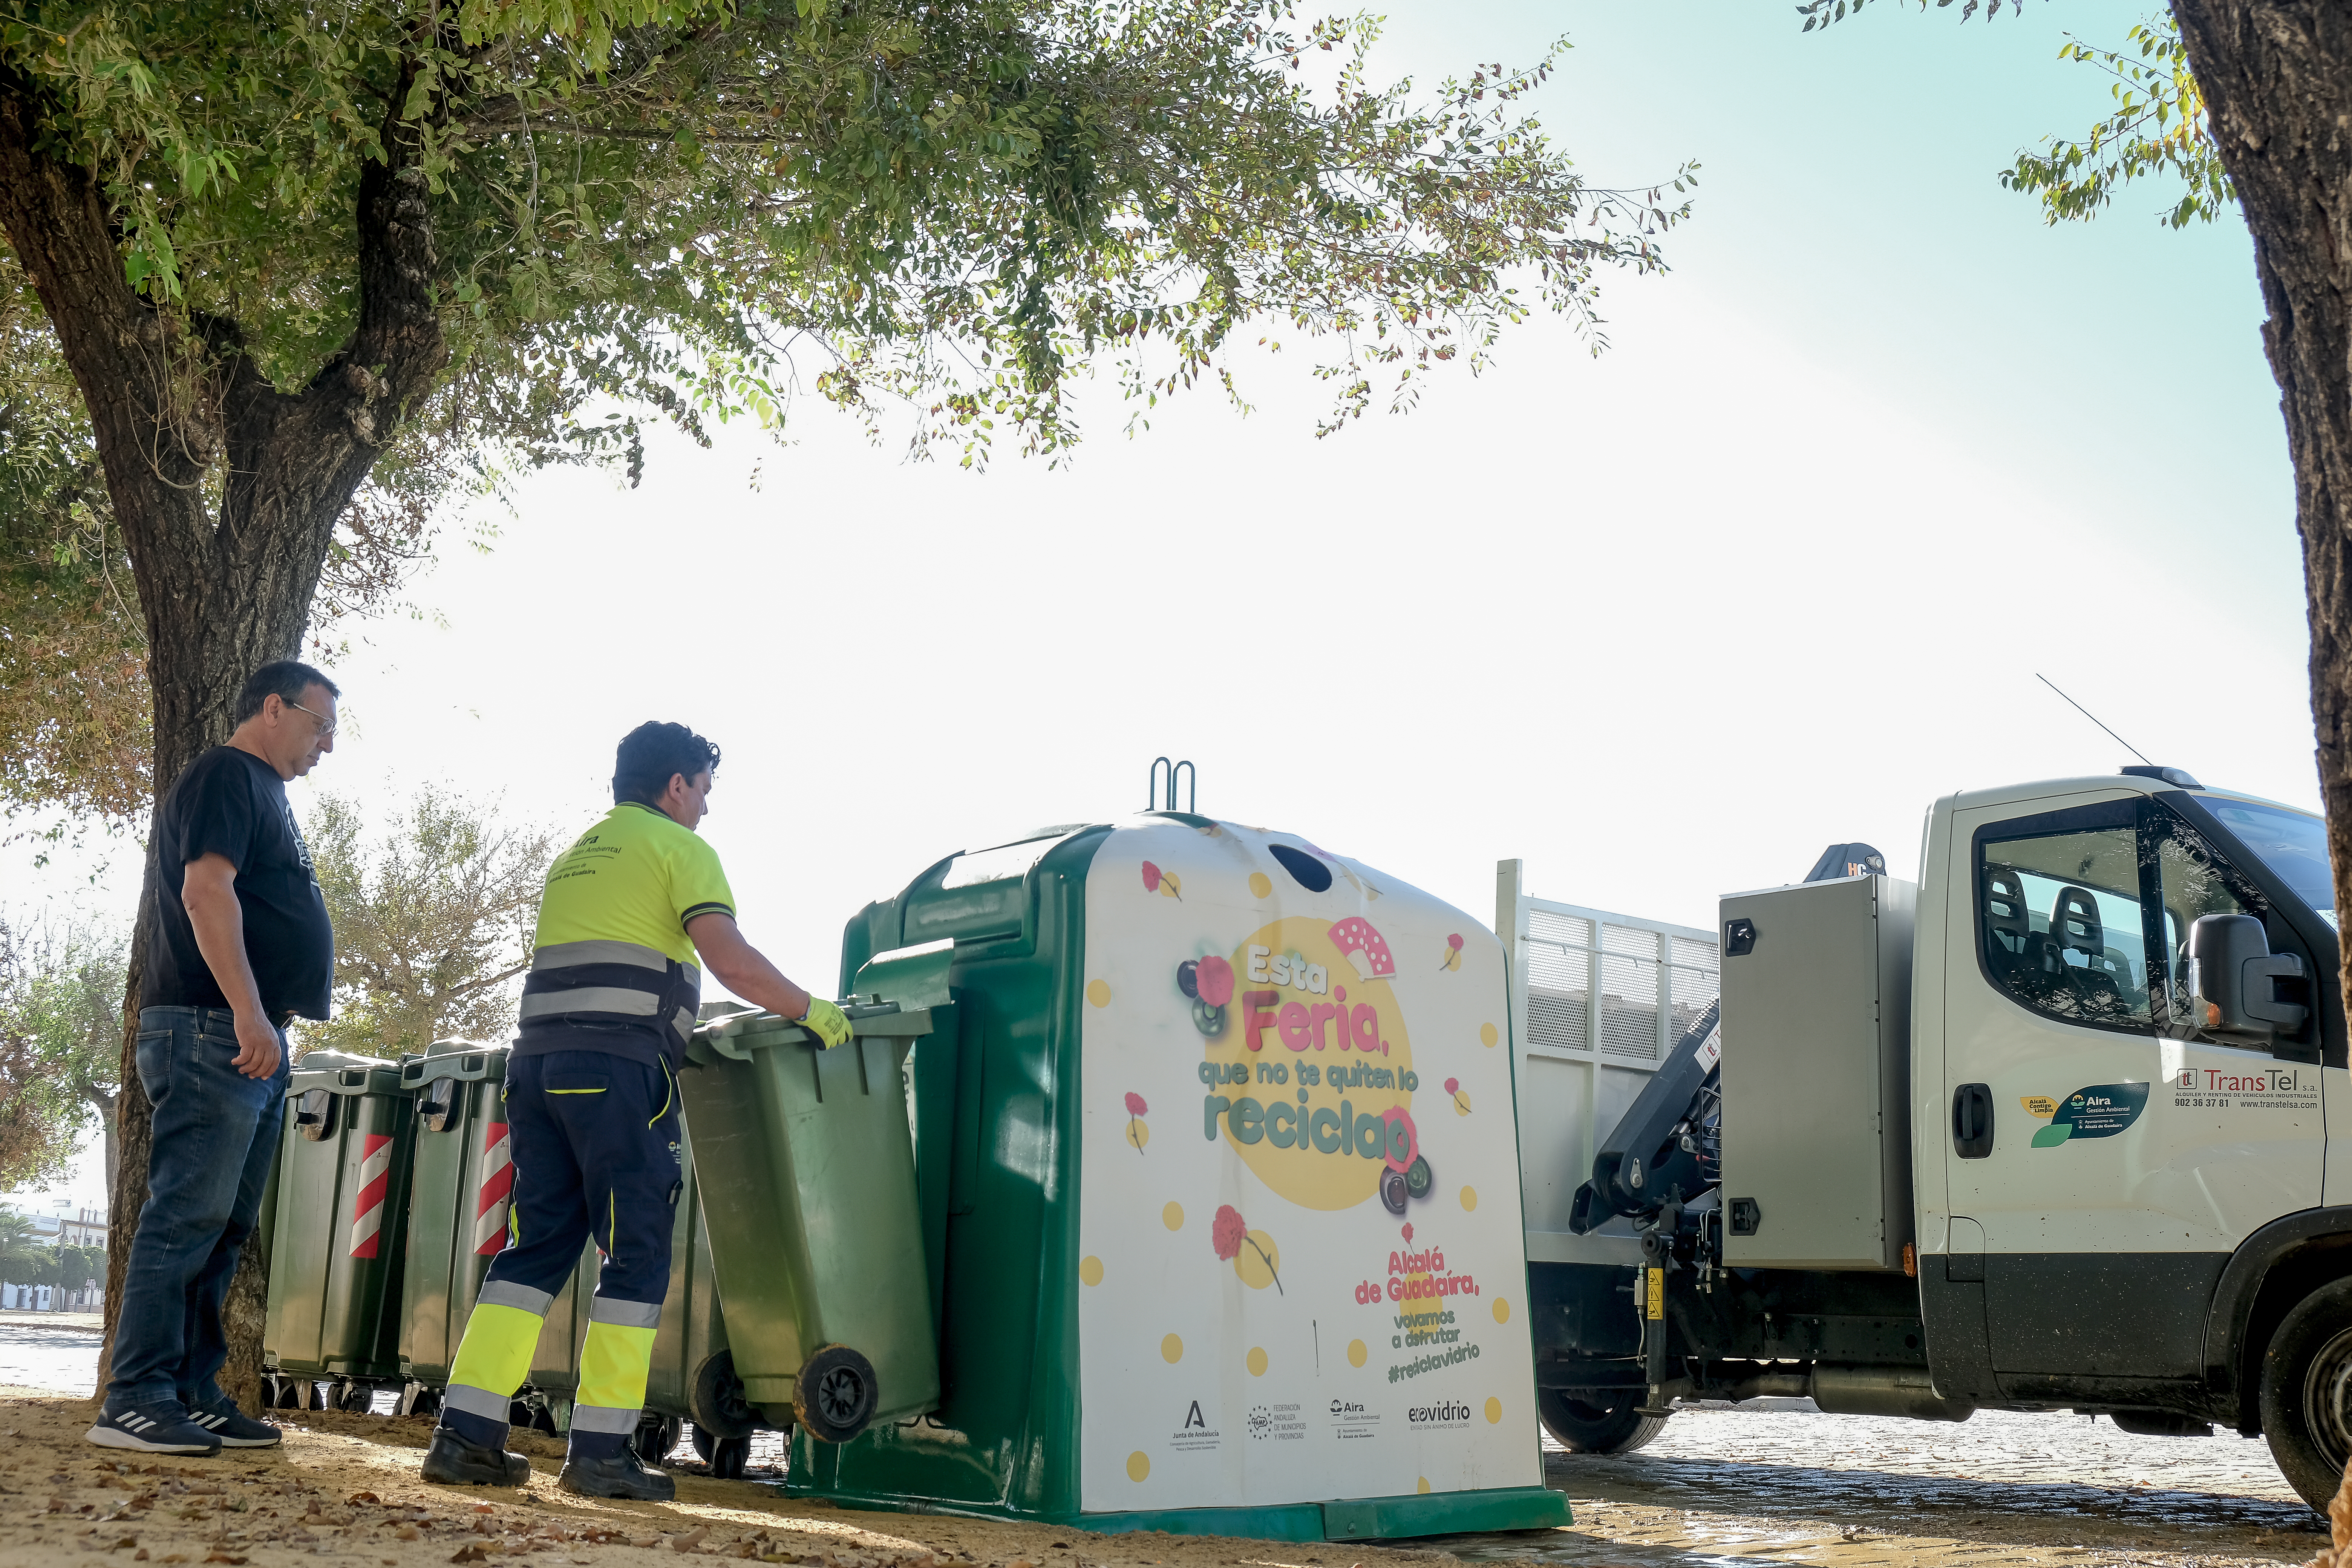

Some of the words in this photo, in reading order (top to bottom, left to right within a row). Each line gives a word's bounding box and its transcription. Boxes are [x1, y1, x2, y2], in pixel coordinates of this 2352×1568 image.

[1247, 944, 1328, 995] Esta
[1242, 985, 1389, 1057] Feria,
[1198, 1061, 1249, 1091] que
[1256, 1062, 1288, 1085] no
[1295, 1059, 1320, 1086] te
[1326, 1059, 1395, 1093] quiten
[1398, 1066, 1418, 1091] lo
[2204, 1069, 2297, 1091] TransTel
[2086, 1096, 2111, 1106] Aira
[2175, 1098, 2190, 1107] 902
[2193, 1098, 2203, 1107] 36
[2206, 1099, 2216, 1107] 37
[2219, 1099, 2229, 1107] 81
[2240, 1100, 2317, 1109] www.transtelsa.com
[1204, 1087, 1410, 1163] reciclao
[1388, 1245, 1444, 1276] Alcalá
[1355, 1280, 1381, 1305] de
[1387, 1270, 1479, 1302] Guadaíra,
[1392, 1335, 1401, 1349] a
[1274, 1403, 1300, 1412] FEDERACIÓN
[1344, 1402, 1364, 1412] Aira
[1409, 1400, 1470, 1422] ecovidrio
